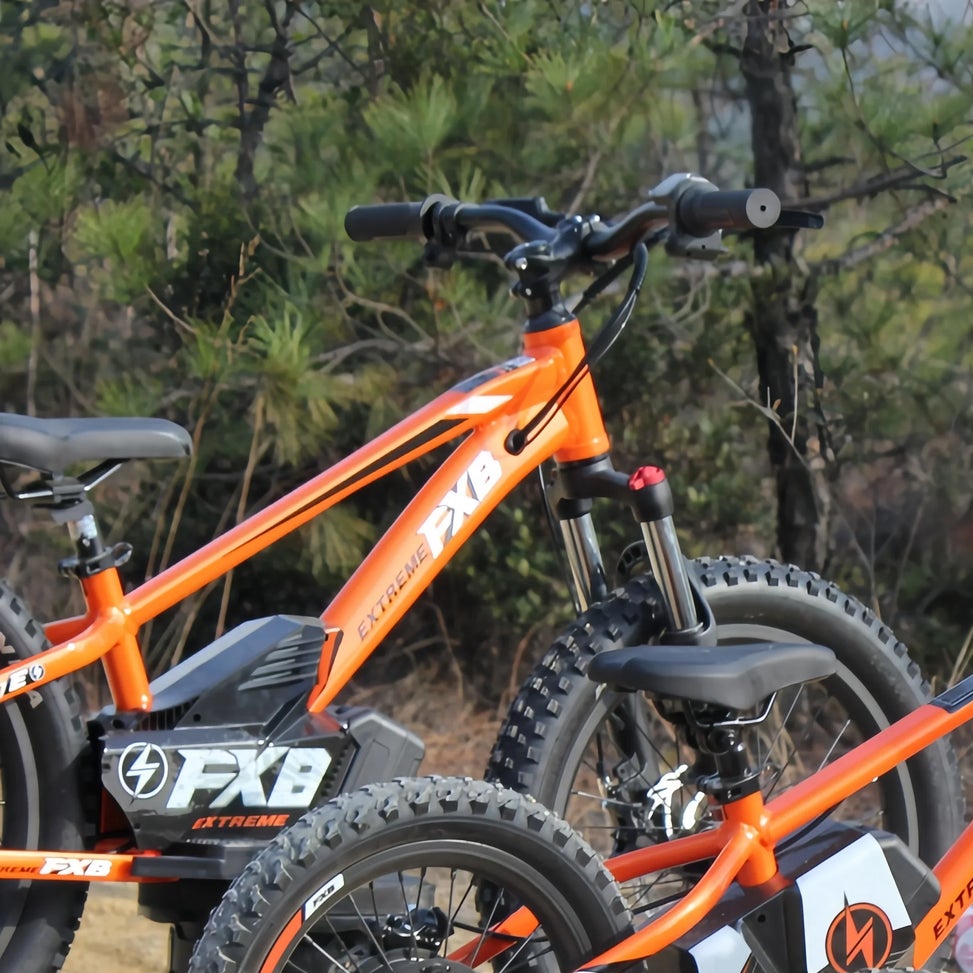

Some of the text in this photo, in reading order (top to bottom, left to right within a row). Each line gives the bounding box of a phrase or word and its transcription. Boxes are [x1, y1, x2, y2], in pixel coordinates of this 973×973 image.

[357, 449, 503, 641] EXTREME FXB
[165, 746, 332, 809] FXB
[191, 814, 290, 830] EXTREME
[39, 856, 113, 877] FXB
